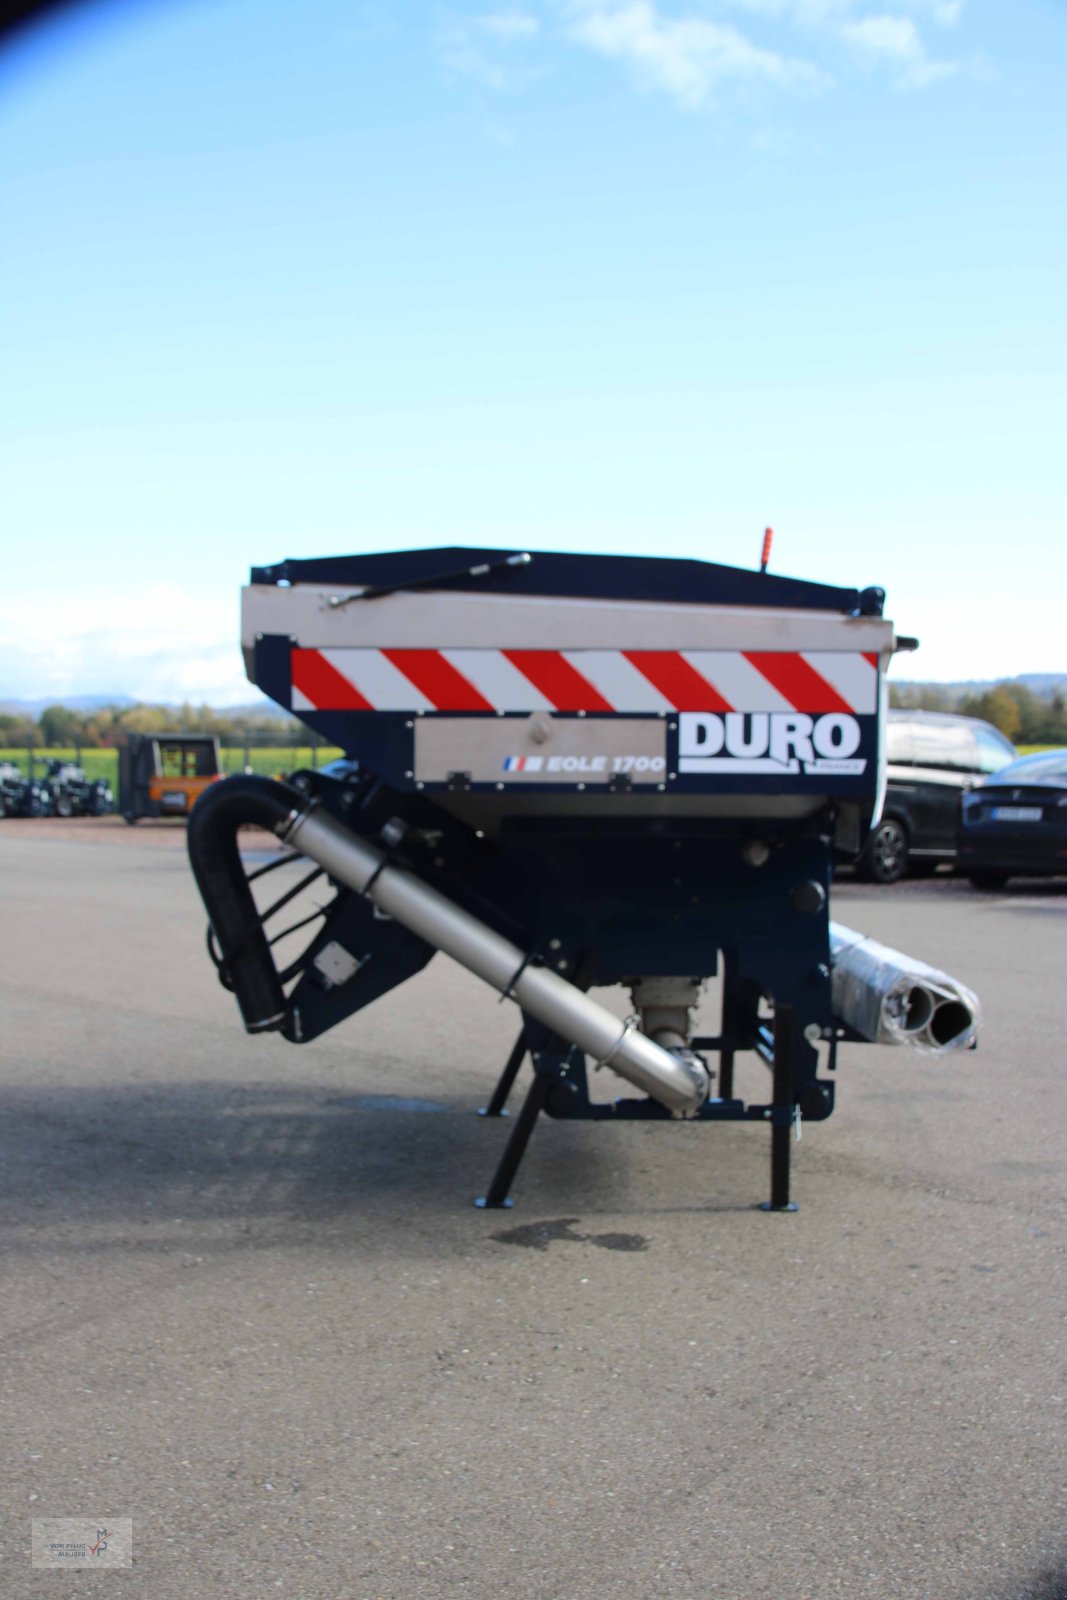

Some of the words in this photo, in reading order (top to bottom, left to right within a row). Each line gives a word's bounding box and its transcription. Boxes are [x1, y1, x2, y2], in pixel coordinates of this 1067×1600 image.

[678, 712, 861, 767] DURO
[547, 755, 608, 772] EOLE
[613, 755, 666, 772] 1700
